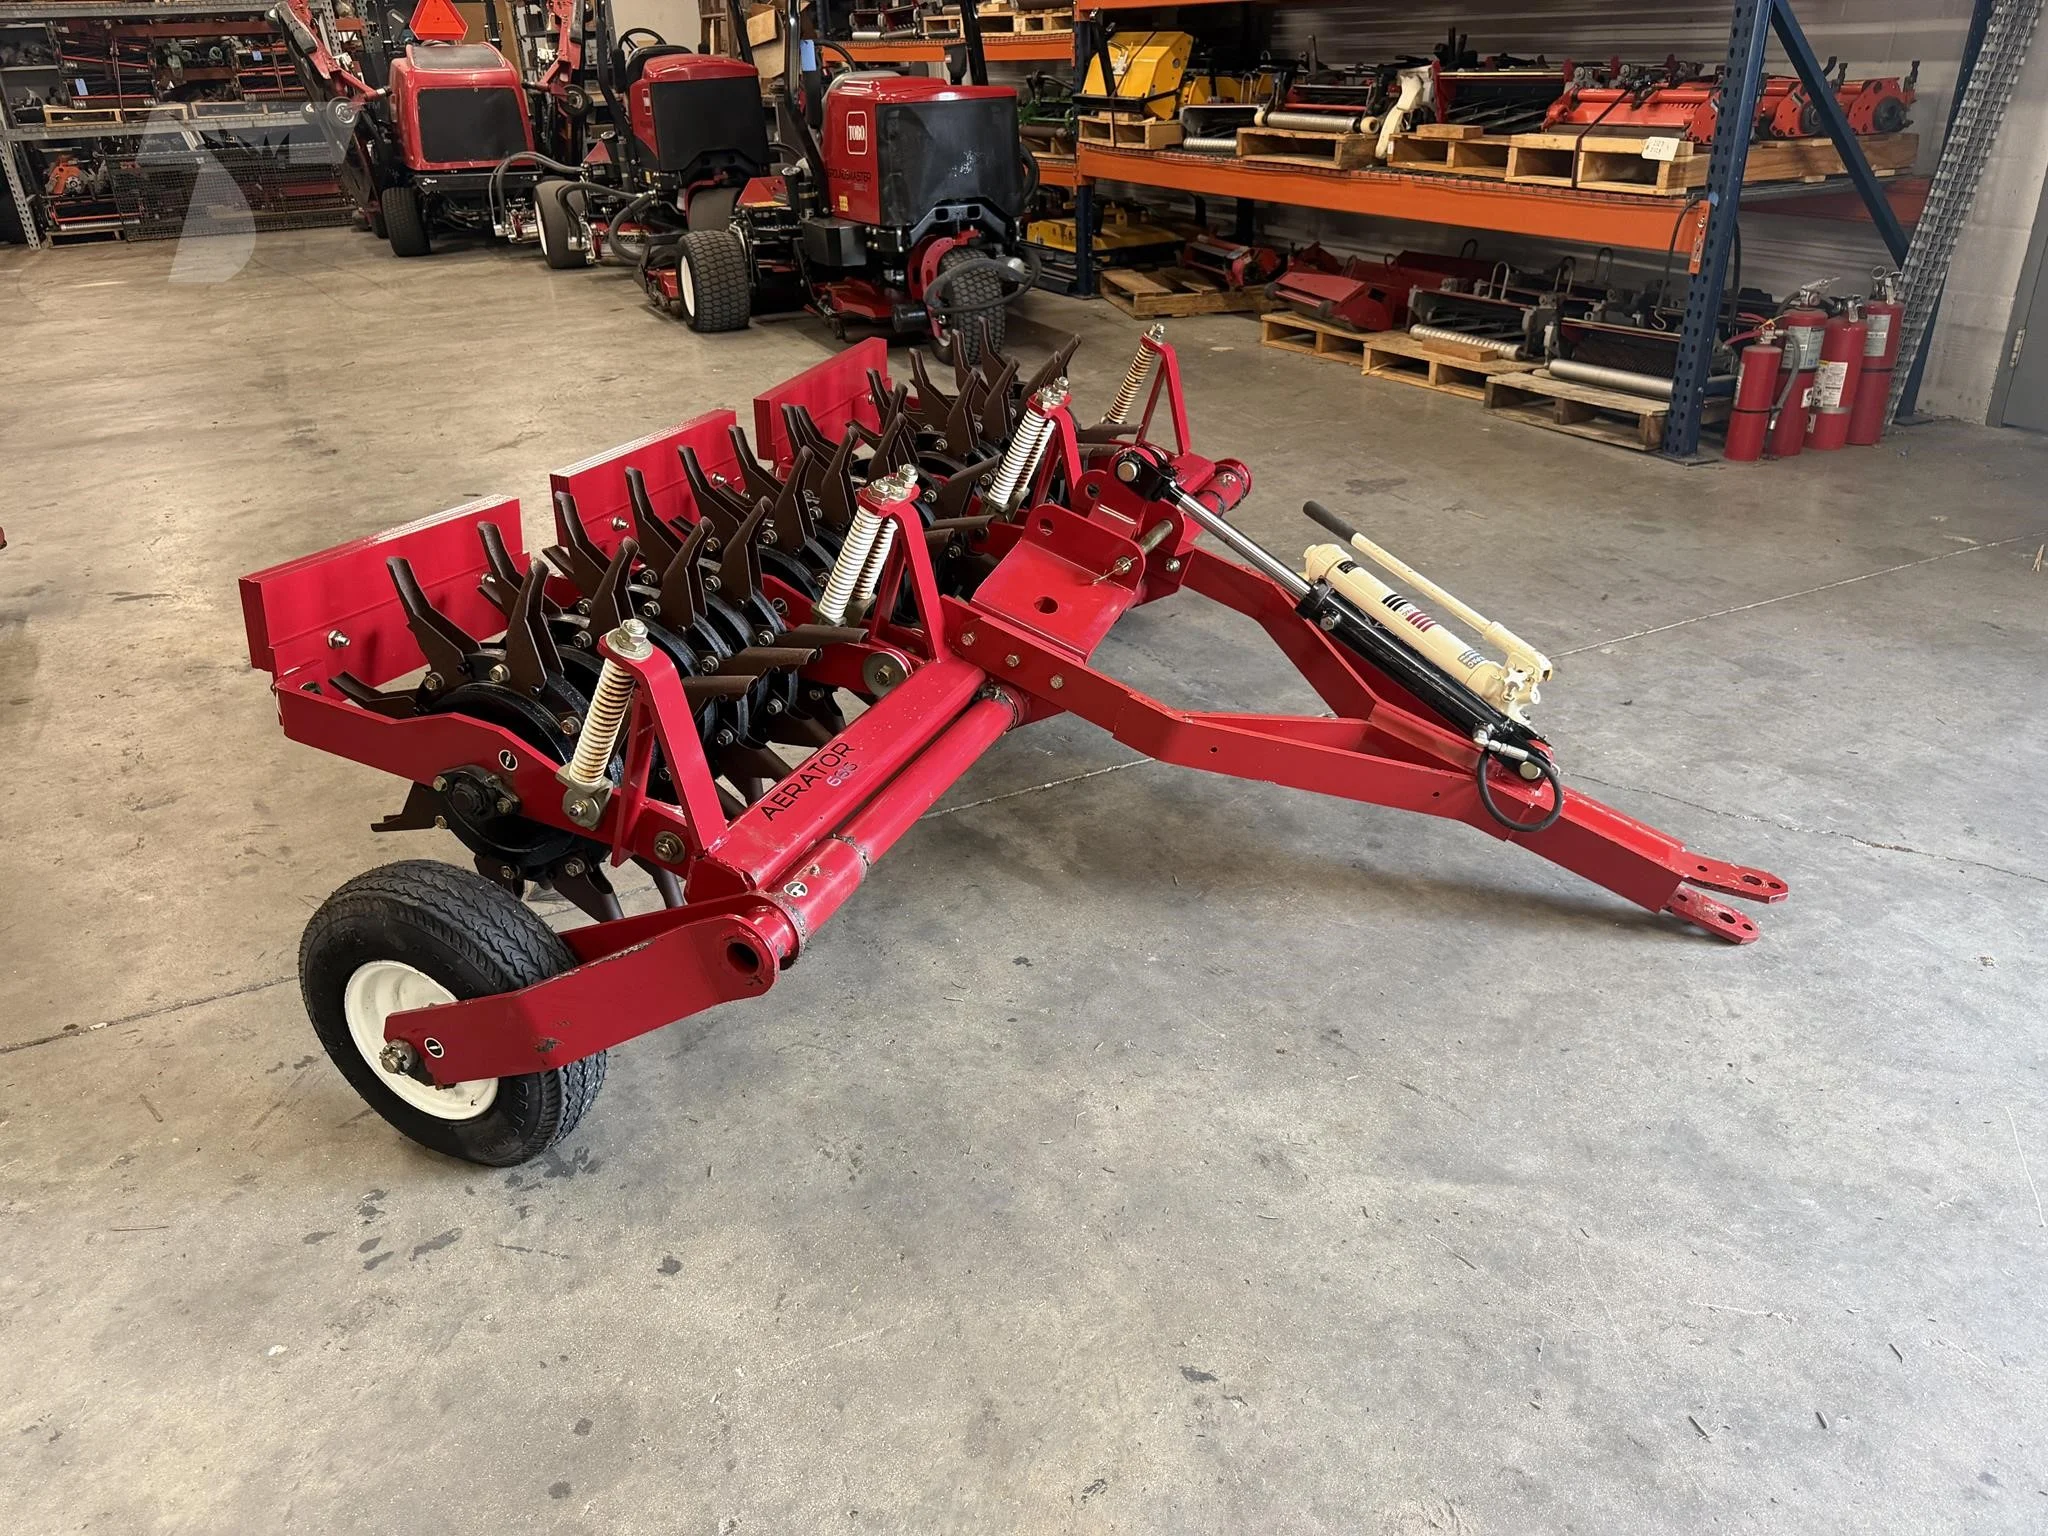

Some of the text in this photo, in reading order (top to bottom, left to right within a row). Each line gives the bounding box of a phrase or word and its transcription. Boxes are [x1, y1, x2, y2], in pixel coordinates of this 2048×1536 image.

[848, 125, 865, 141] TORO
[827, 168, 872, 182] ROUNDSMASTER
[760, 742, 855, 822] AERATOR
